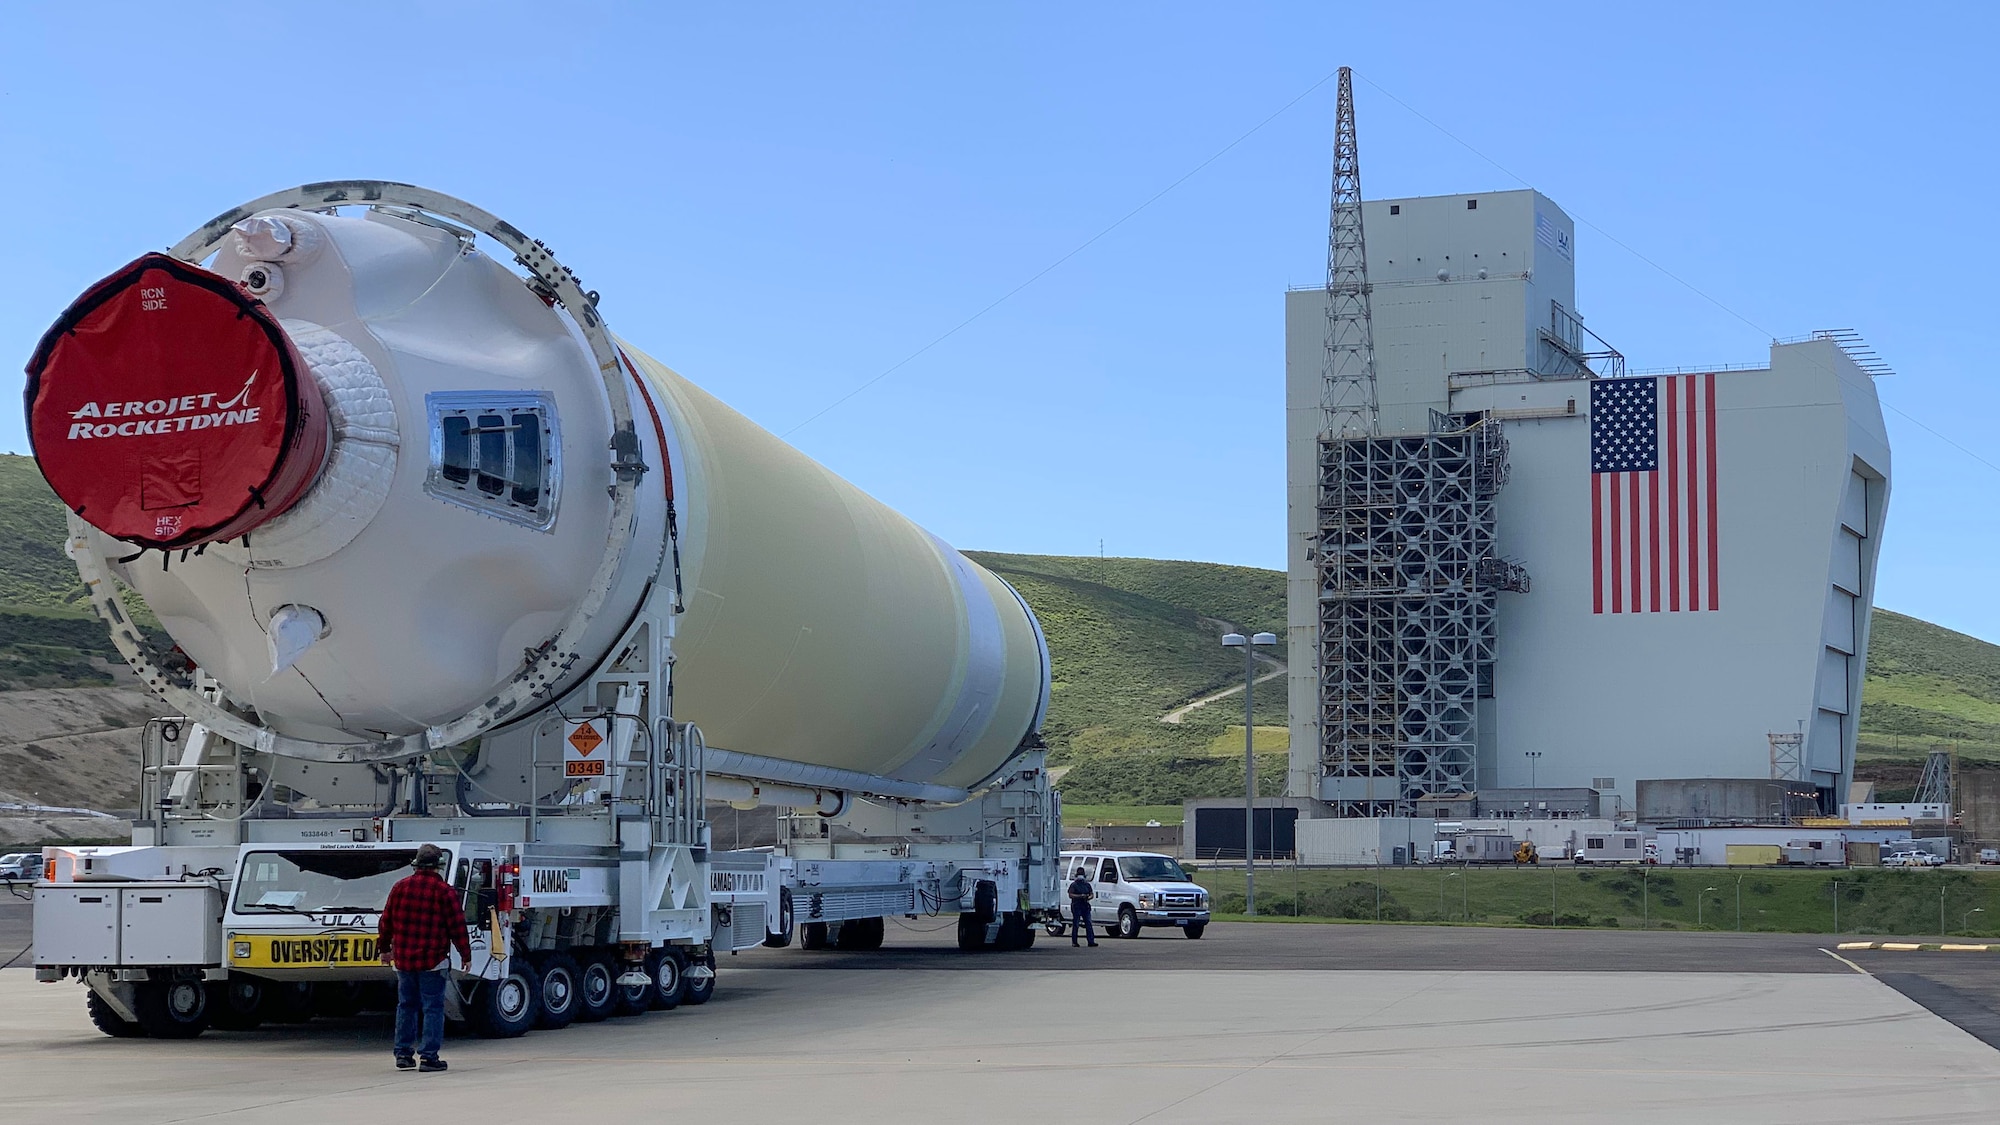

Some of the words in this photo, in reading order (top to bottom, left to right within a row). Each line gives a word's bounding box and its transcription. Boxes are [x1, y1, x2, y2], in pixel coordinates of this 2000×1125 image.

[141, 287, 165, 299] RCN
[142, 299, 167, 310] SIDE
[68, 392, 217, 419] AEROJET
[67, 407, 260, 440] ROCKETDYNE
[156, 516, 182, 526] HEX
[154, 525, 181, 536] SIDE
[569, 762, 602, 774] 0349
[533, 869, 568, 893] KAMAG
[321, 915, 366, 926] ULA
[271, 939, 349, 963] OVERSIZE
[353, 938, 380, 962] LOA
